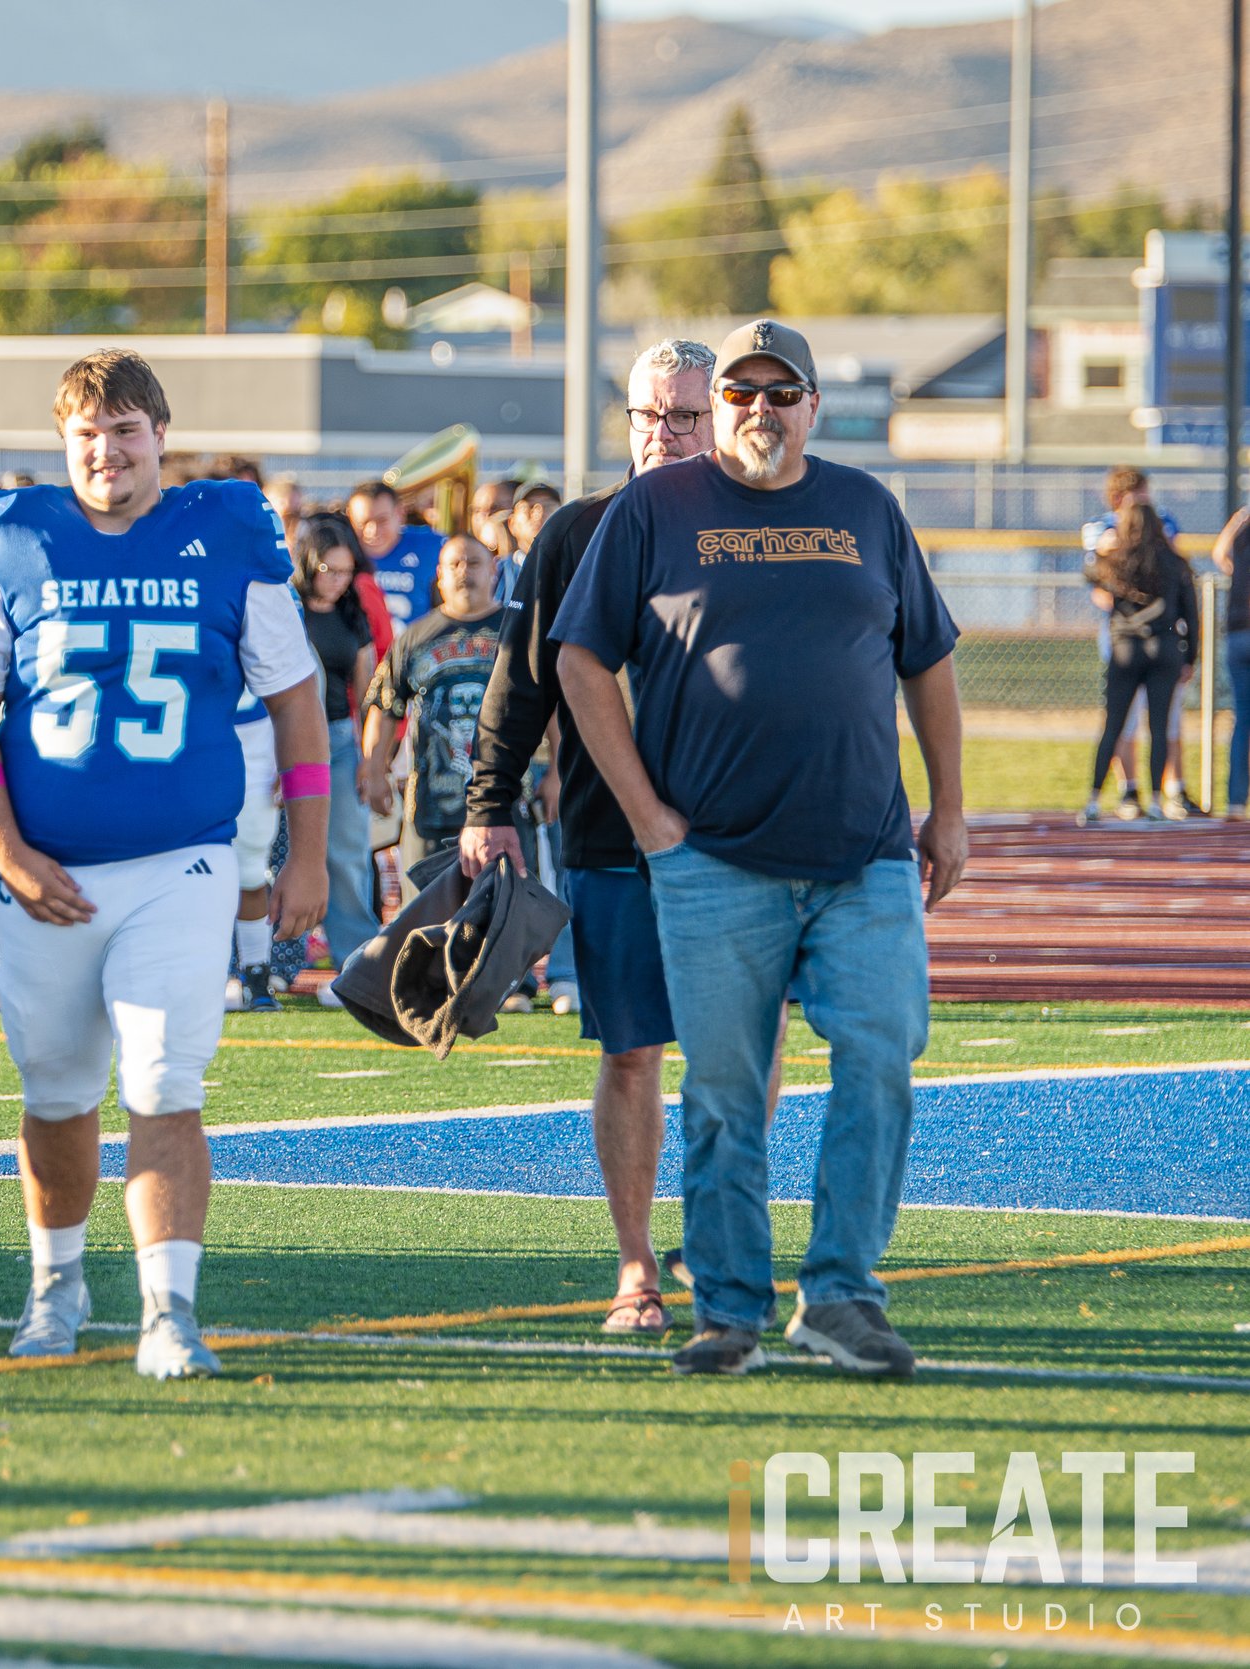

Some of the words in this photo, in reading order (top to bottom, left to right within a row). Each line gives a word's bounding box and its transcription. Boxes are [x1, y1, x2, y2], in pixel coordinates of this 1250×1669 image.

[697, 527, 859, 558] carhartt
[700, 554, 729, 566] EST.
[734, 553, 764, 562] 1889
[41, 577, 199, 612] SENATORS
[30, 620, 200, 764] 55
